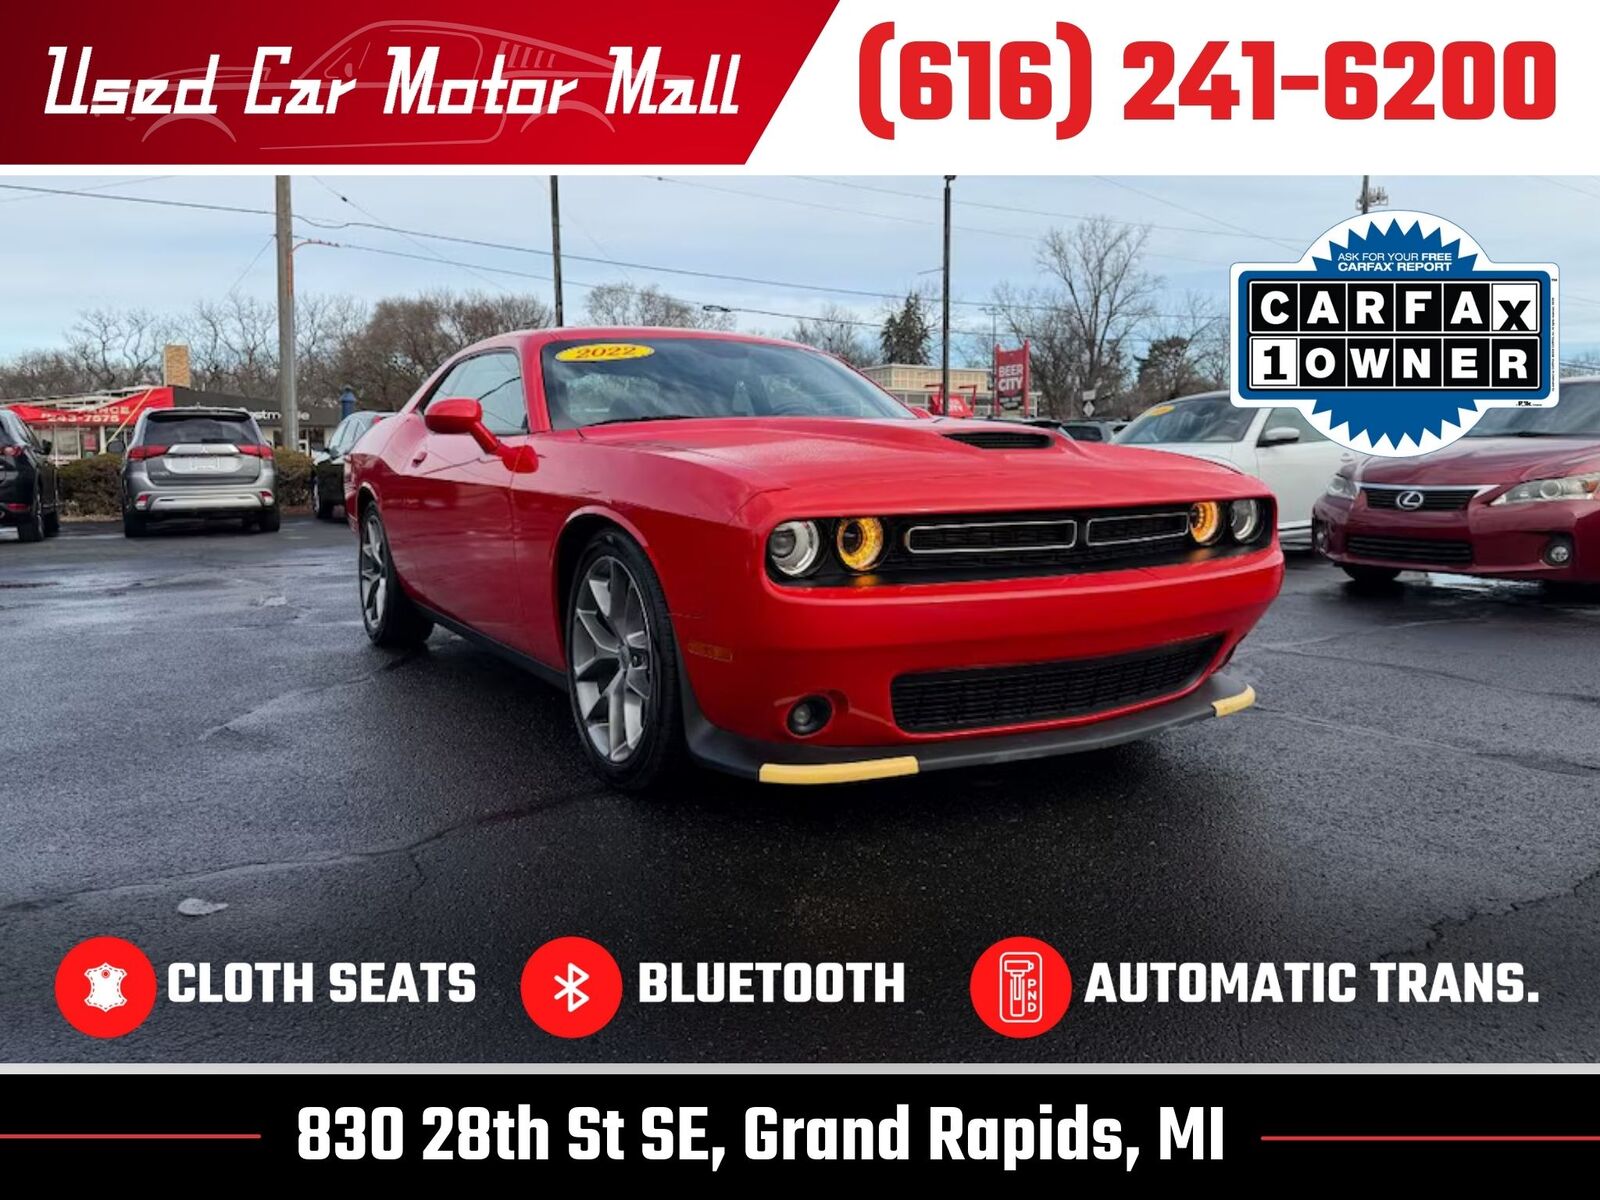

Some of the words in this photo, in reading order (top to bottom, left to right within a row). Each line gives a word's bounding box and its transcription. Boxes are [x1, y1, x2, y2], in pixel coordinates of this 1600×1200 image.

[576, 346, 636, 359] 2022
[999, 364, 1023, 376] BEER
[999, 378, 1023, 390] CITY
